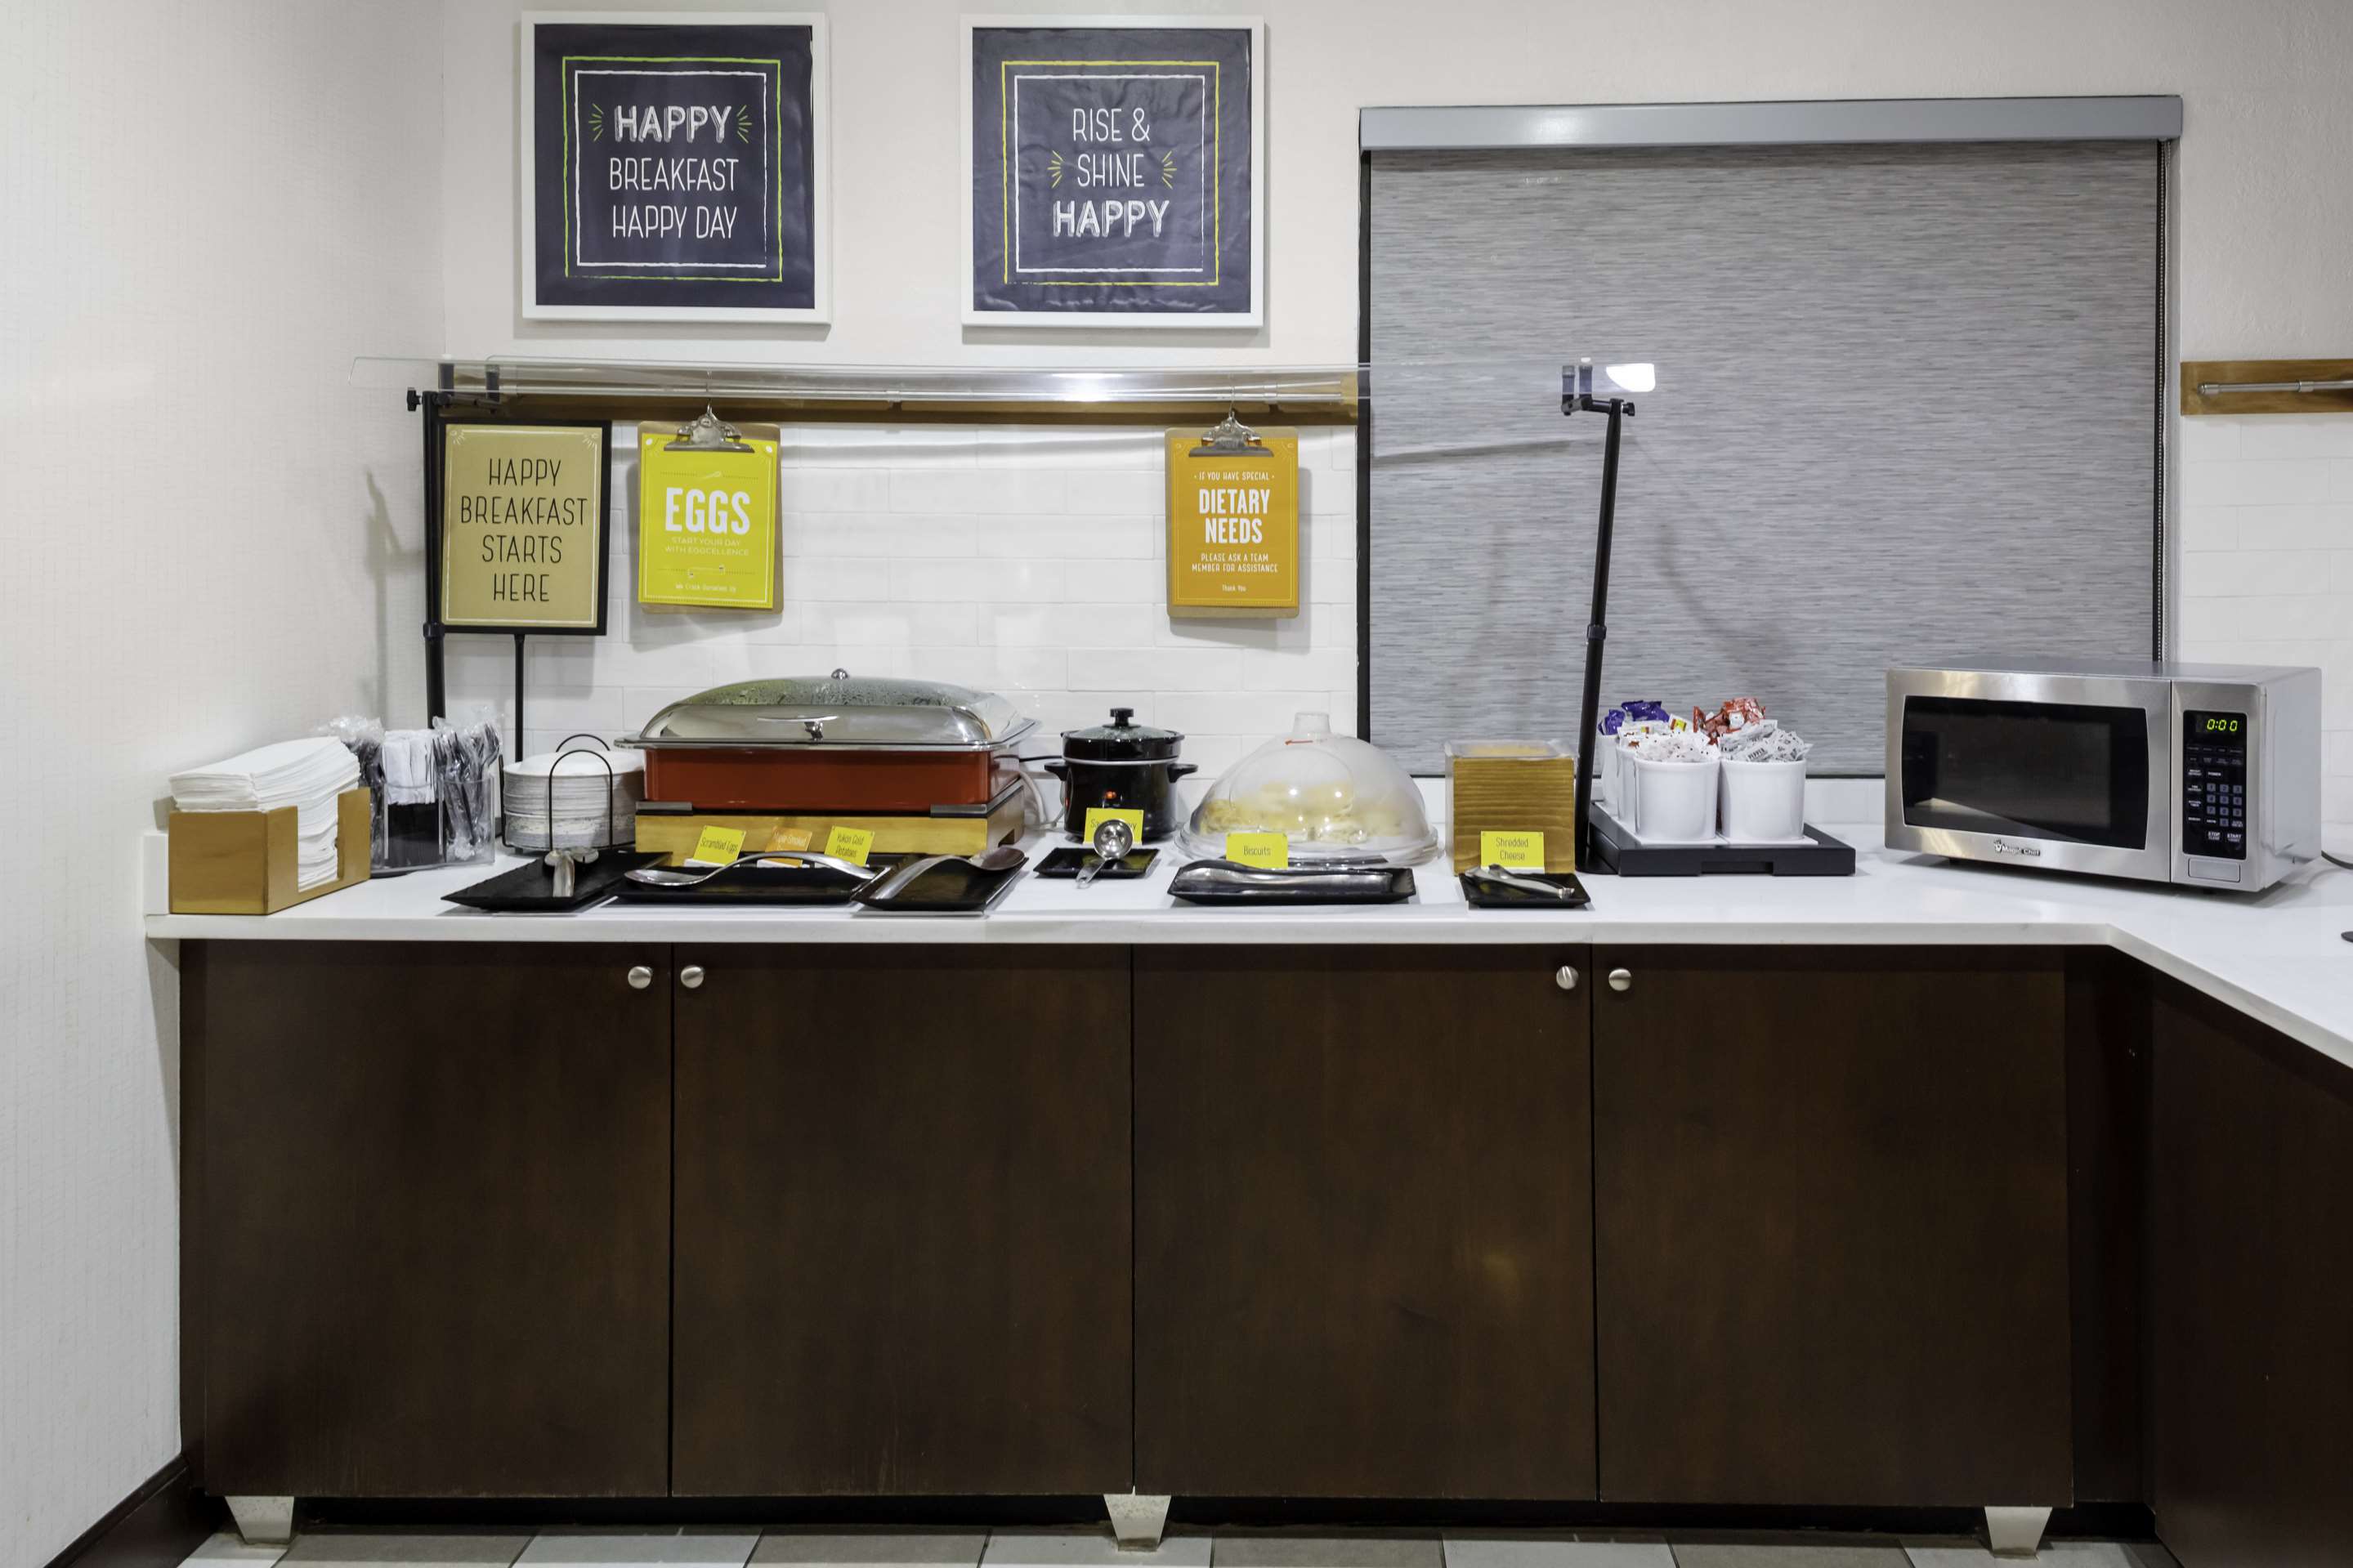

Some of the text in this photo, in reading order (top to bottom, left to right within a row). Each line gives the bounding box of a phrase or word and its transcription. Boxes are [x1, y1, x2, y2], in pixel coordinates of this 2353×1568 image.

[615, 105, 731, 142] HAPPY
[1073, 108, 1150, 141] RISE &
[610, 158, 739, 191] BREAKFAST
[1077, 154, 1144, 187] SHINE
[613, 205, 737, 239] HAPPY DAY
[1053, 200, 1170, 237] HAPPY
[489, 458, 561, 486] HAPPY
[1199, 471, 1269, 480] IF YOU HAVE SPECIAL
[460, 496, 588, 526] BREAKFAST
[664, 487, 751, 534] EGGS
[1199, 489, 1270, 514] DIETARY
[672, 536, 741, 547] START YOUR DAY
[1205, 518, 1263, 544] NEEDS
[482, 534, 563, 564] STARTS
[664, 545, 749, 556] WITH EGGCELLENCE
[1201, 553, 1268, 562] PLEASE ASK A TEAM
[1192, 563, 1278, 572] MEMBER FOR ASSISTANCE
[493, 574, 550, 602] HERE
[1222, 583, 1236, 592] Thank
[2207, 718, 2238, 732] 0:00
[700, 836, 727, 851] Scrambled
[836, 845, 857, 857] Potatoes
[1243, 846, 1271, 856] Biscuits
[1496, 837, 1528, 847] Shredded
[1500, 850, 1525, 860] Cheese
